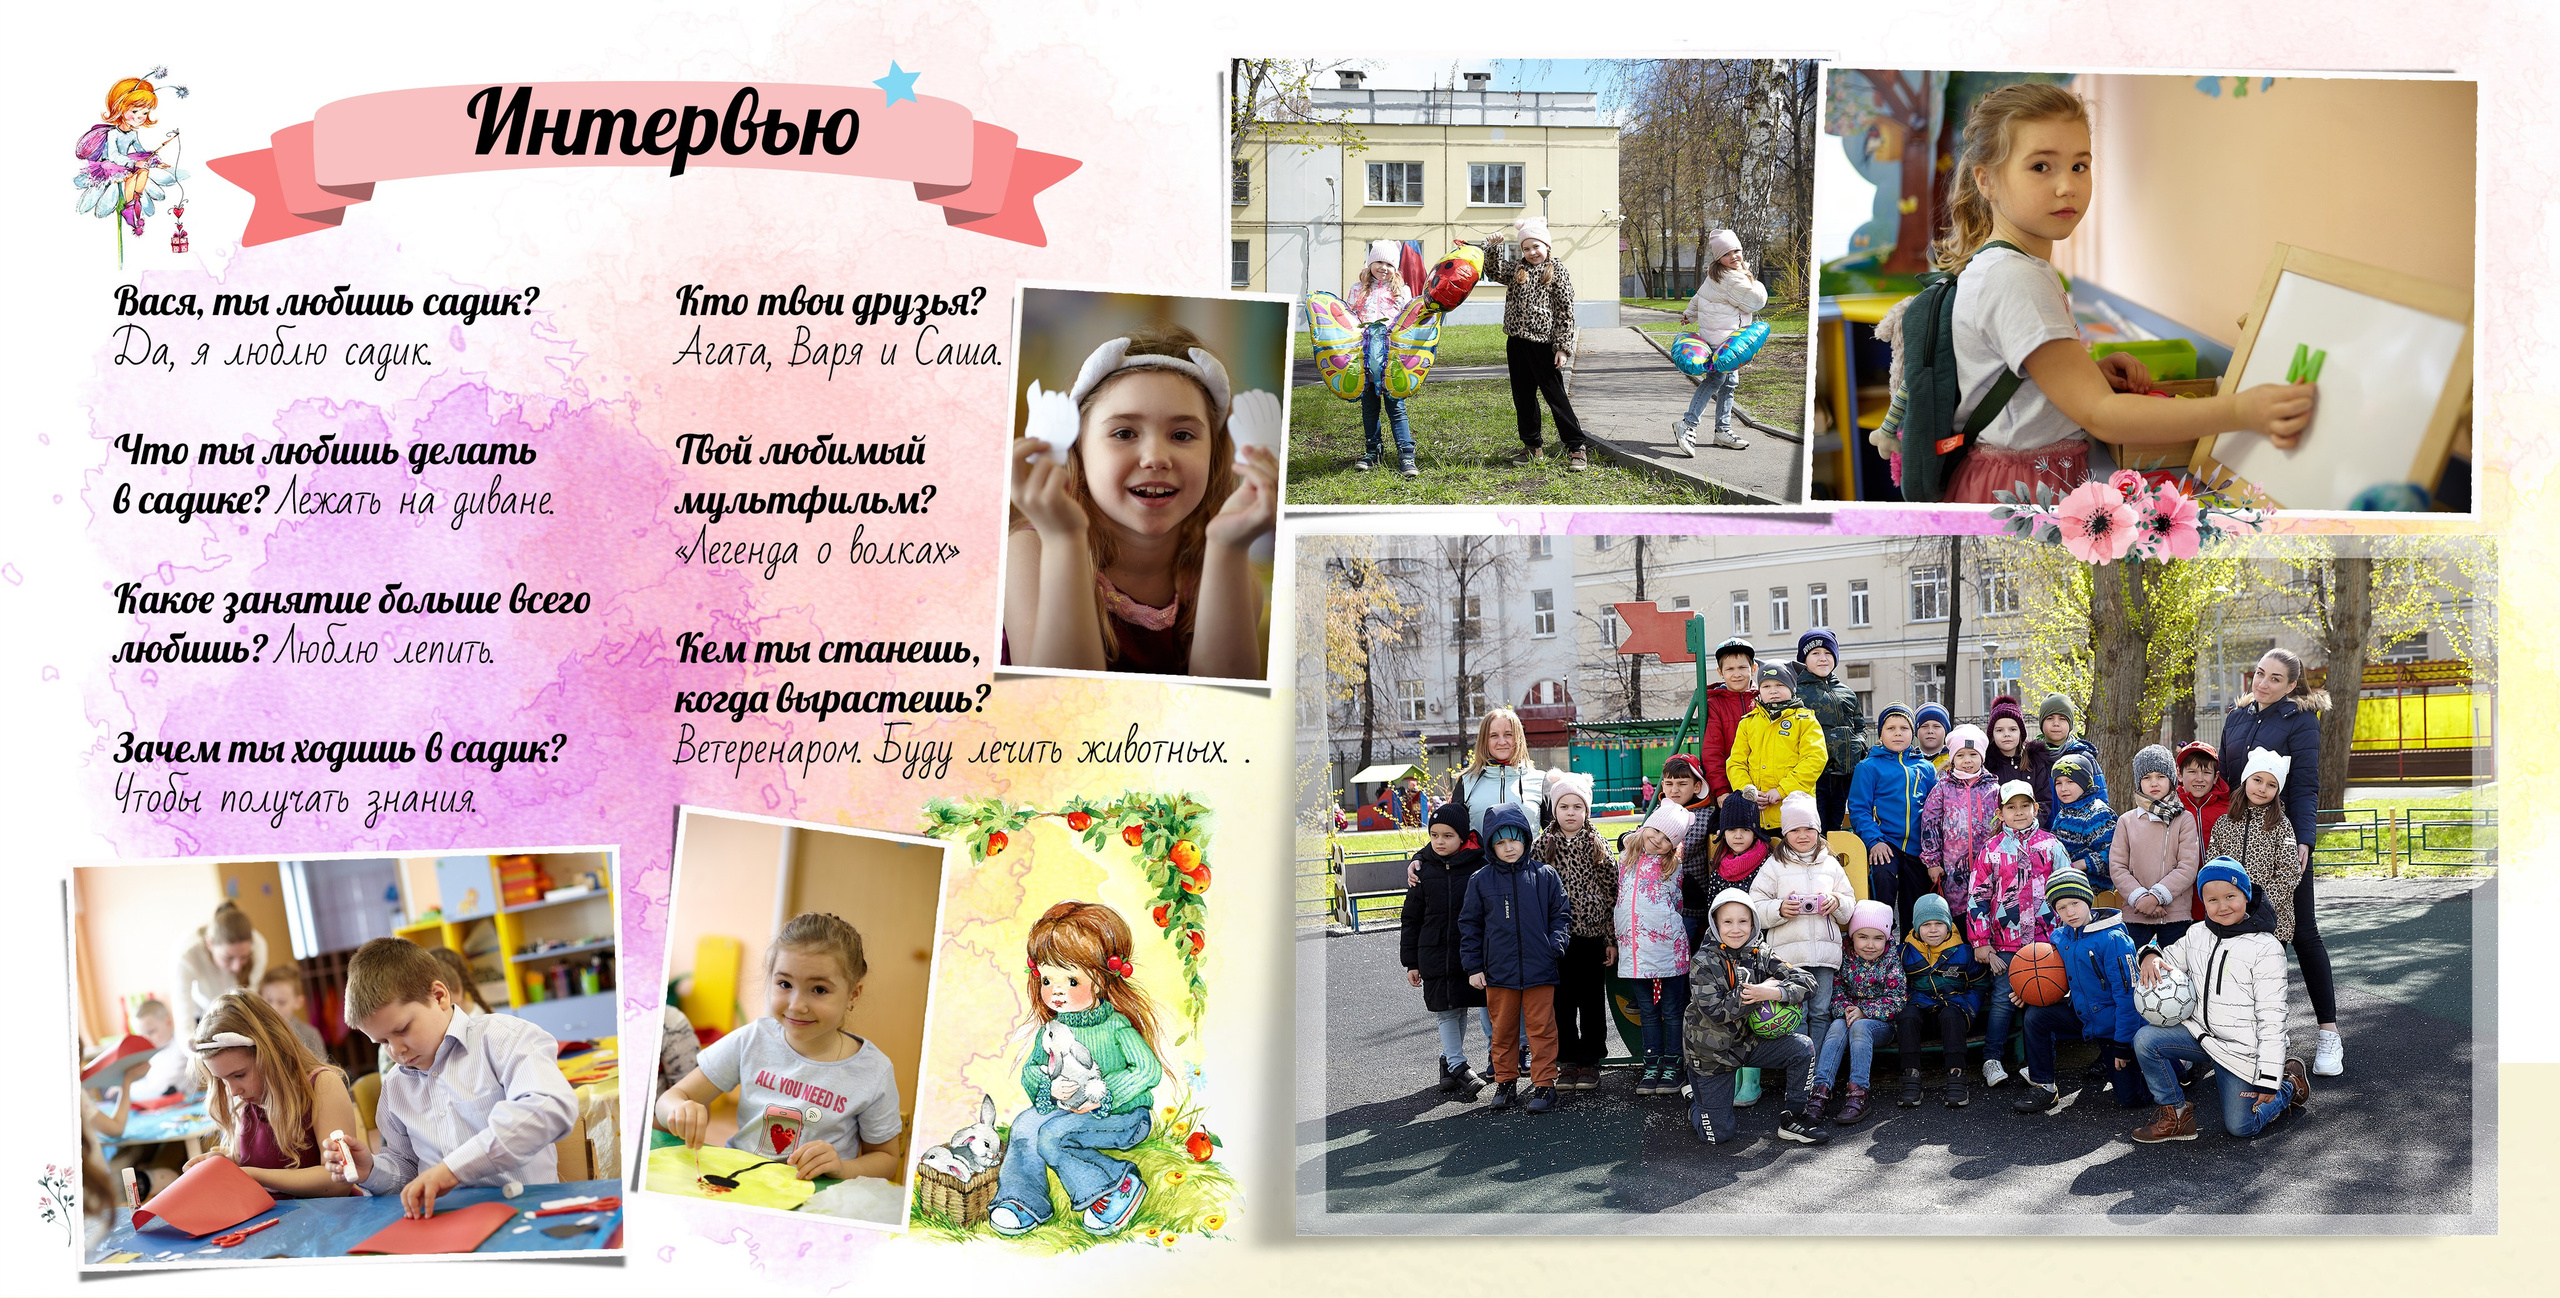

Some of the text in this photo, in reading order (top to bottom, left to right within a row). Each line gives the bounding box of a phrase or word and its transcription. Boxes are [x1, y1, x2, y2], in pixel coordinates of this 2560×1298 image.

[754, 1070, 848, 1114] ALL YOU NEED IS
